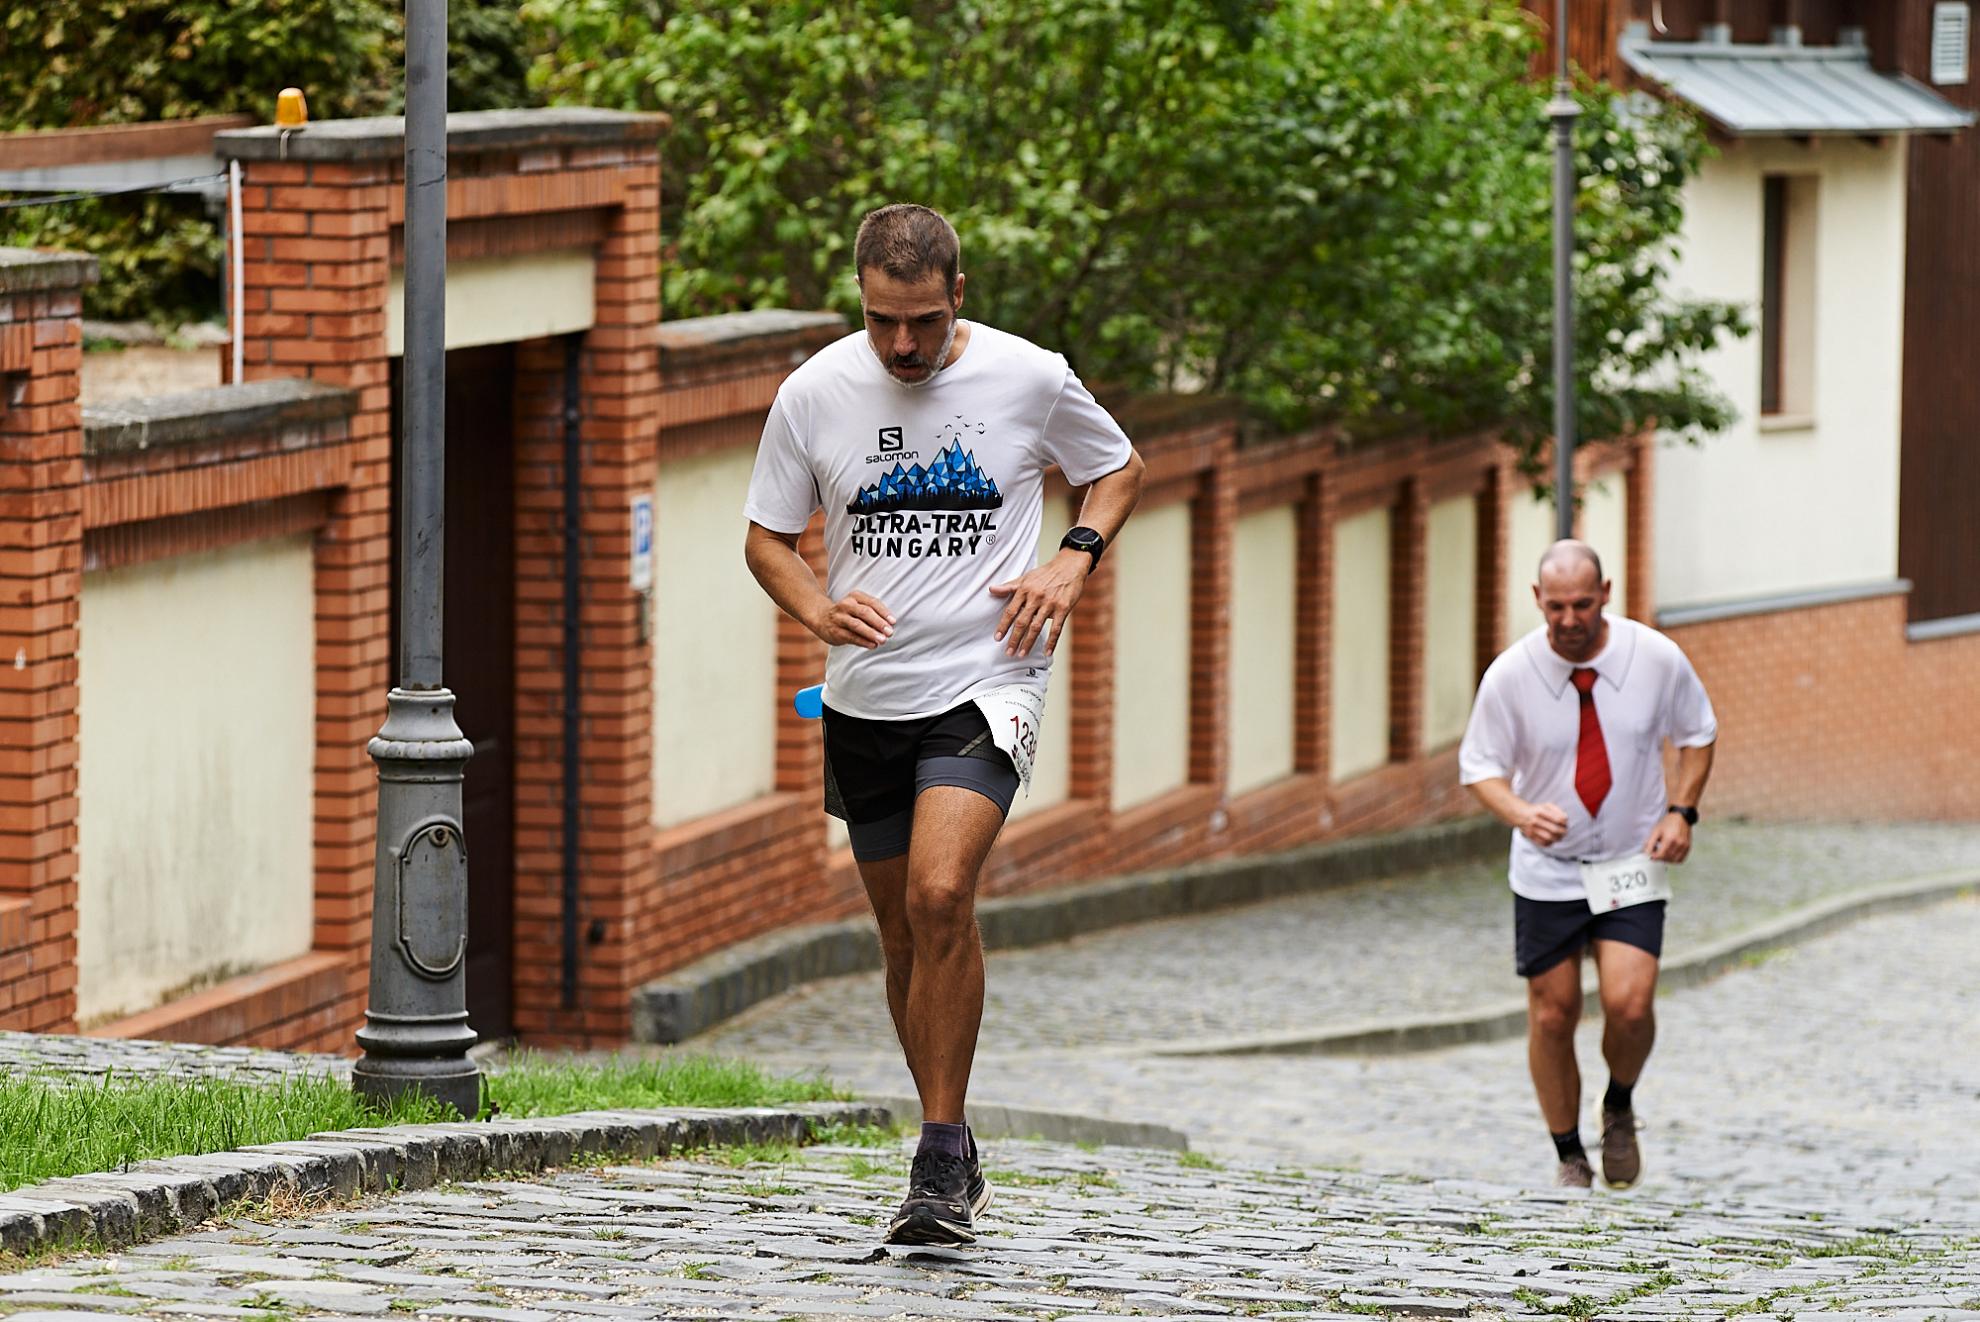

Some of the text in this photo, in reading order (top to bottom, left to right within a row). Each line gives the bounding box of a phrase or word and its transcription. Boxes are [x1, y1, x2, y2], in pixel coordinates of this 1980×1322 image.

[852, 512, 997, 534] ULTRA-TRAIL
[851, 535, 982, 558] HUNGARY
[1608, 870, 1648, 893] 320
